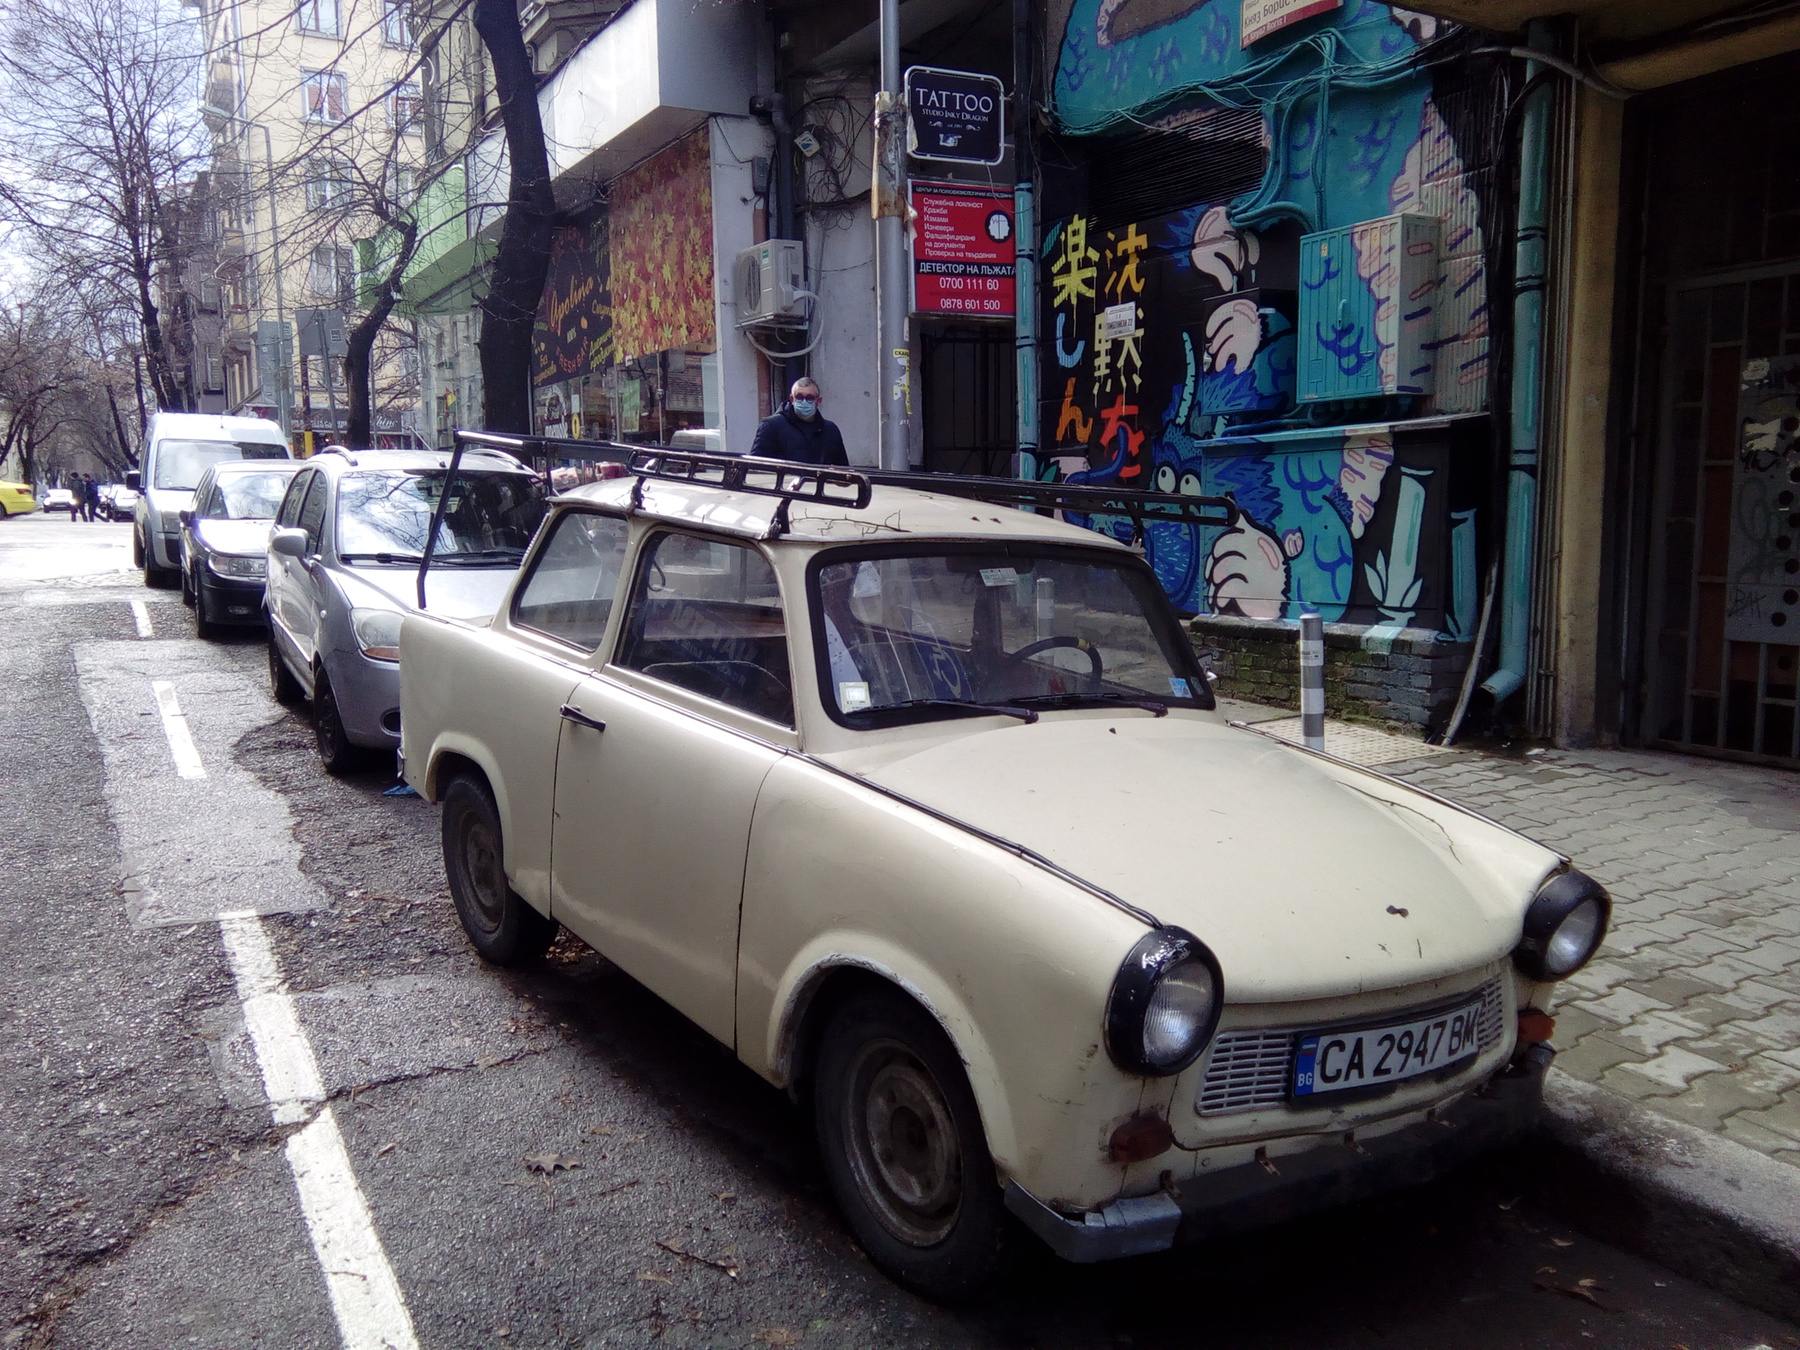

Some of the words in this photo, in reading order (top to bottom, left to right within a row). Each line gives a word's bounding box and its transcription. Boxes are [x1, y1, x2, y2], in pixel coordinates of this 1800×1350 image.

[1244, 11, 1261, 29] Княз
[1263, 0, 1291, 17] Борис
[1266, 18, 1283, 31] Boris
[915, 87, 993, 113] TATTOO
[923, 197, 954, 207] Служебна
[923, 206, 948, 215] Кражби
[924, 214, 949, 223] Измами
[924, 223, 954, 232] Изневери
[925, 248, 956, 257] Проверка
[933, 242, 966, 250] документи
[919, 262, 965, 274] ДЕТЕКТОР
[966, 263, 979, 274] НА
[980, 264, 1015, 276] ЛЪЖАТА
[939, 277, 964, 289] 0700
[966, 278, 983, 290] 111
[986, 279, 999, 291] 60
[940, 298, 963, 310] 0878
[964, 299, 981, 310] 601
[983, 300, 1001, 311] 500
[1319, 1036, 1365, 1084] CA
[1372, 1019, 1449, 1078] 2947
[1449, 1006, 1480, 1057] BM
[1297, 1072, 1313, 1087] BG
